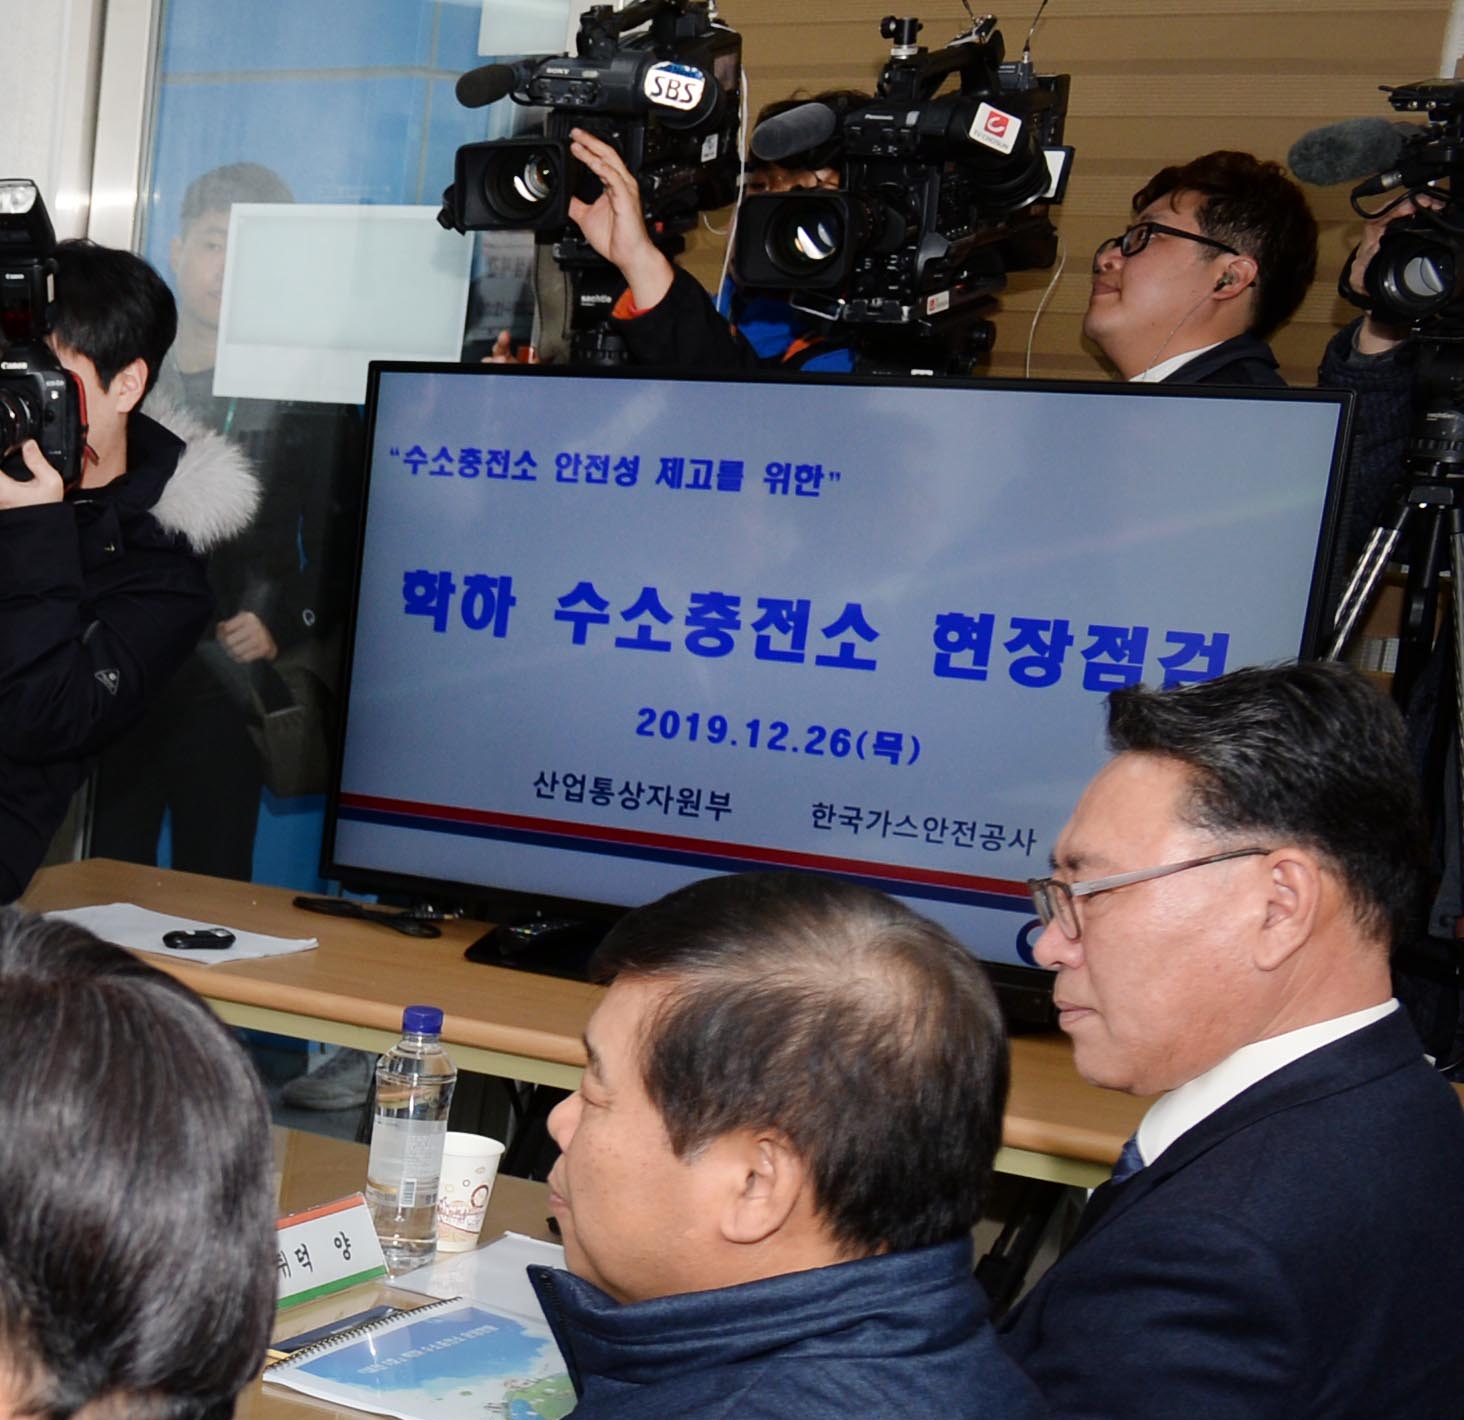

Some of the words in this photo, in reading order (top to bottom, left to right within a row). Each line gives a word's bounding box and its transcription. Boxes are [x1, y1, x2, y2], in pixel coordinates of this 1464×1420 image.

[650, 76, 695, 103] SBS
[555, 452, 640, 488] 안전성
[655, 457, 744, 493] 제고를
[402, 569, 516, 639] 학하
[554, 582, 880, 671] 수소충전소
[933, 612, 1230, 693] 현장점검
[636, 707, 922, 766] 2019.12.26(목)
[533, 770, 733, 822] 산업통상자원부
[811, 802, 1038, 857] 한국가스안전공사
